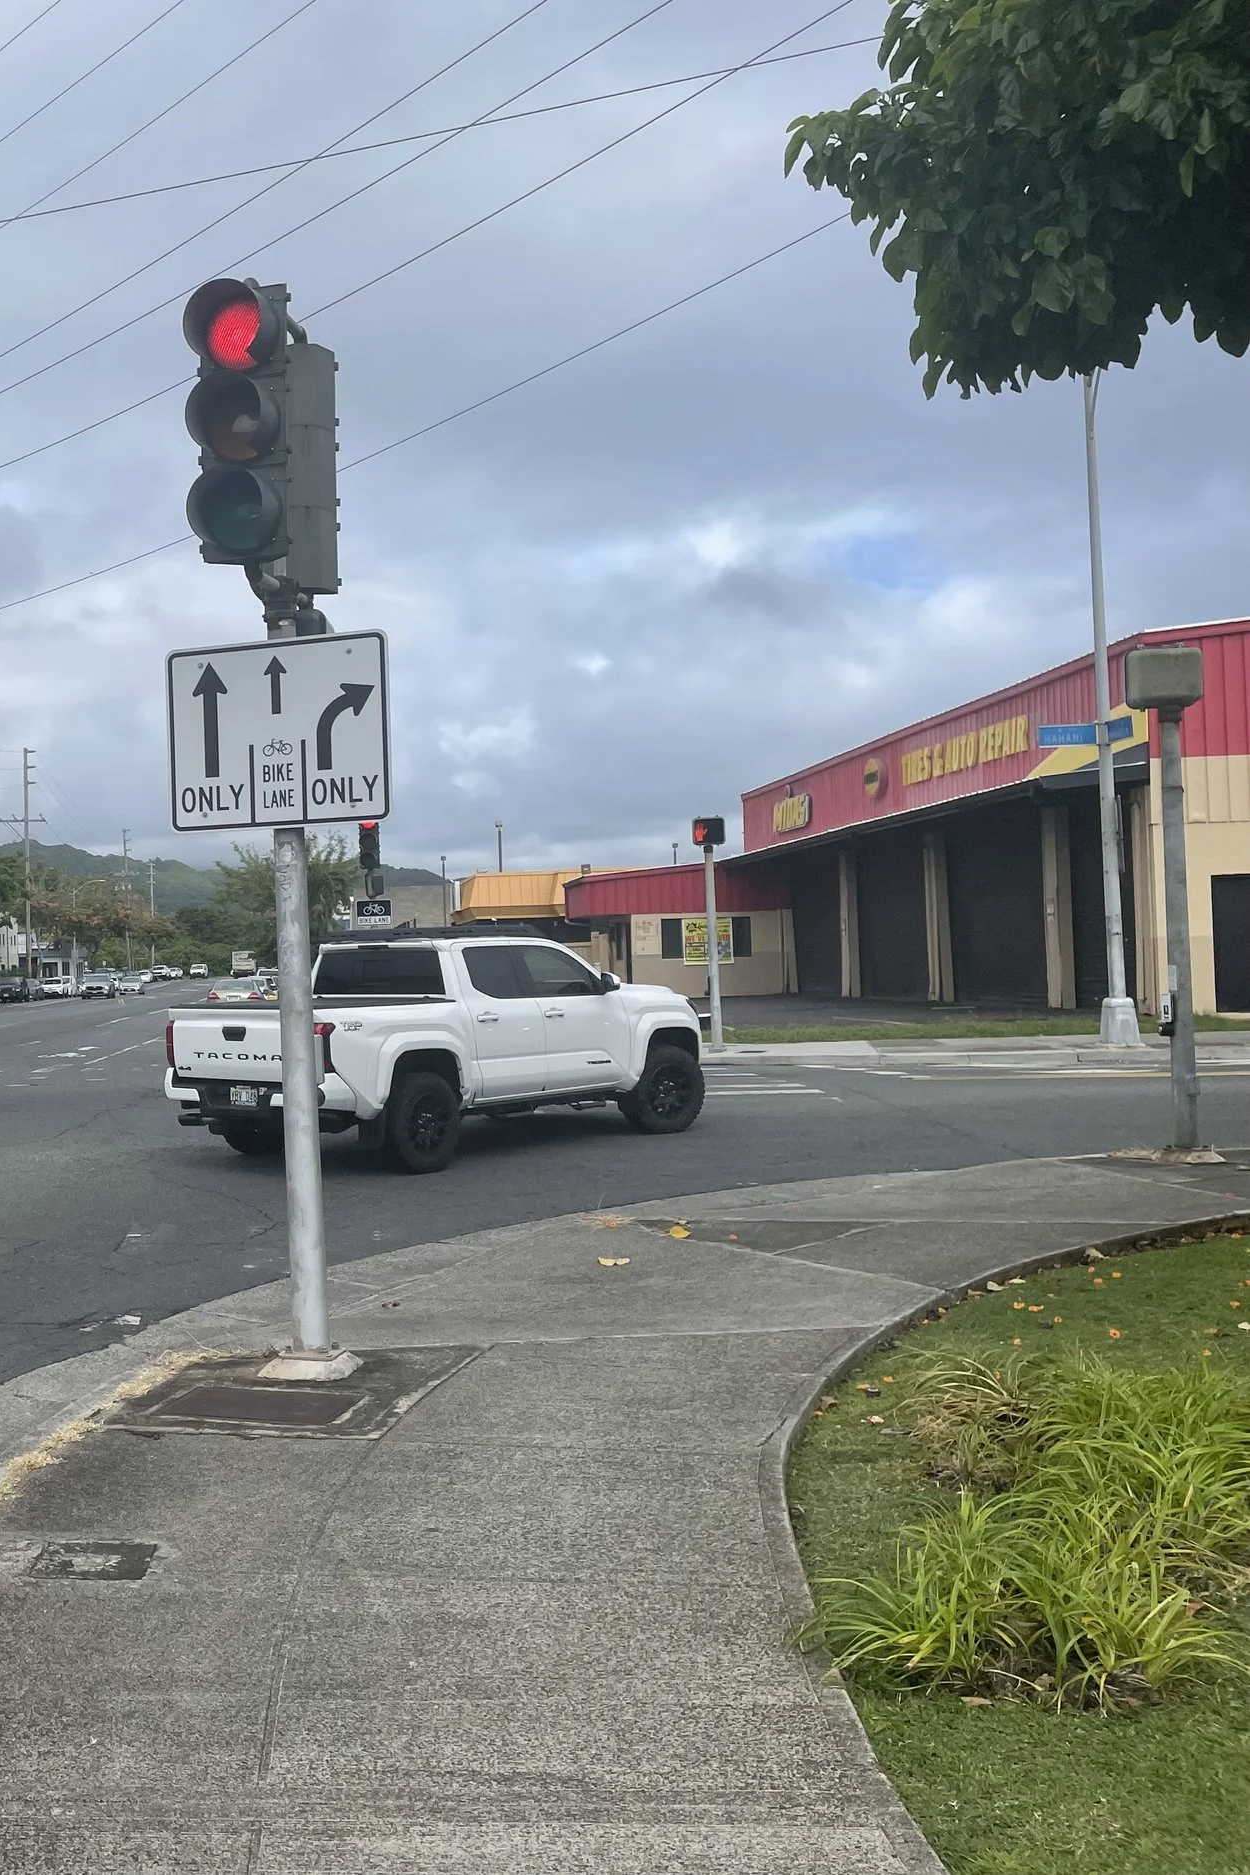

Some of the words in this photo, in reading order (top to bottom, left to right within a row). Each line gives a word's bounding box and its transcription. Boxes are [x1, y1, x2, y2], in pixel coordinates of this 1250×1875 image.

[901, 746, 932, 787] TIRES
[933, 743, 944, 777] &
[945, 731, 978, 774] AUTO
[978, 714, 1029, 764] REPAIR
[262, 763, 294, 783] BIKE
[181, 783, 245, 813] ONLY
[263, 789, 295, 809] LANE
[311, 774, 379, 805] ONLY
[193, 1051, 282, 1062] TACOMA
